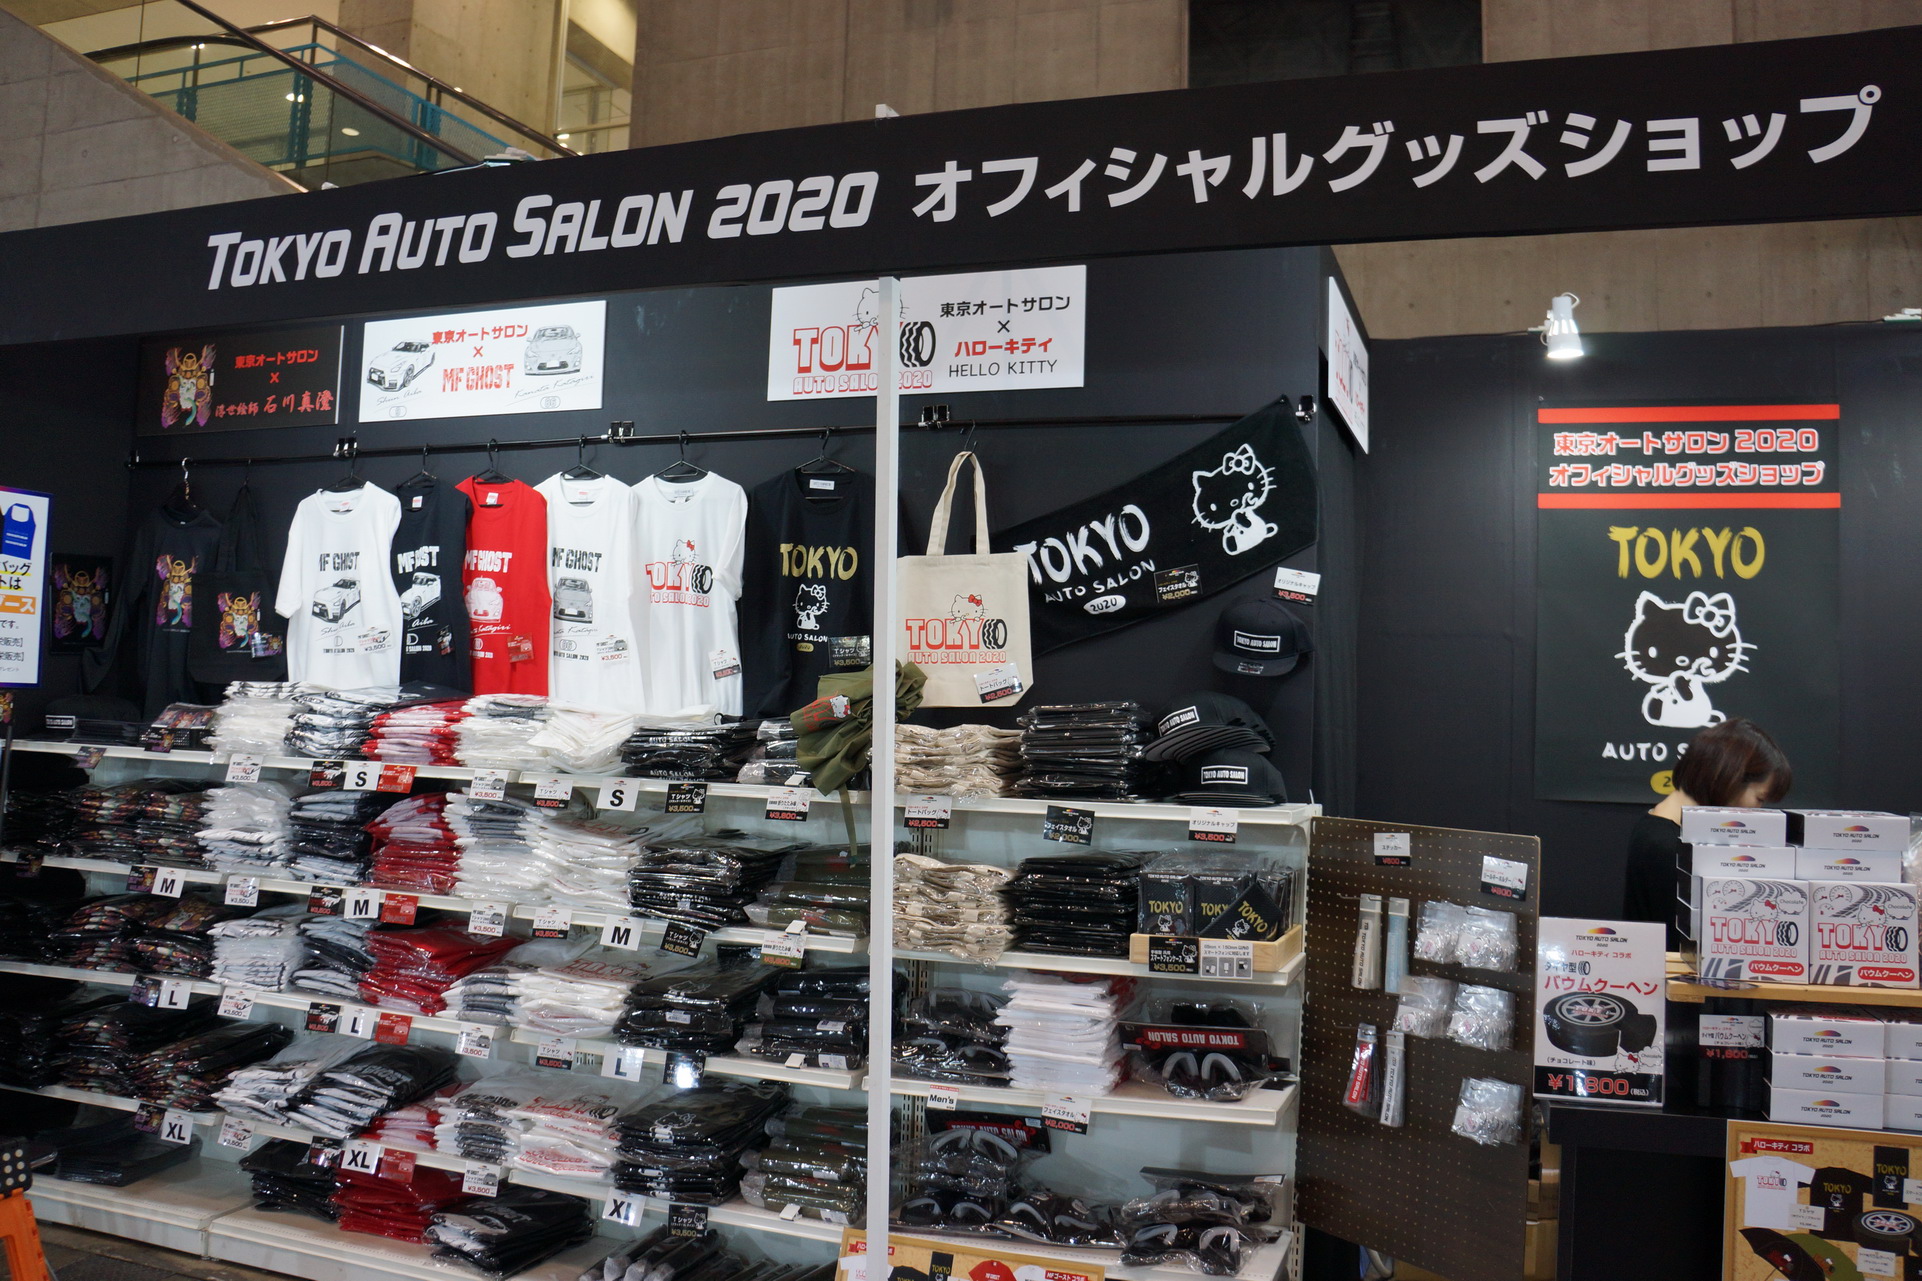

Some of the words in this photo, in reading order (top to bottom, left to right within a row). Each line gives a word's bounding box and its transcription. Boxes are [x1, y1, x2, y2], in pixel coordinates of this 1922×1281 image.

[207, 228, 352, 290] TOKYO
[358, 211, 498, 274] AUTO
[506, 189, 694, 258] SALON
[707, 171, 879, 239] 2020
[913, 84, 1882, 223] オフィシャルグッズショップ
[940, 296, 1070, 317] 東京オートサロン
[432, 325, 529, 345] 東京オートサロン
[955, 337, 1053, 357] ハローキティ
[235, 350, 318, 369] 東京オートサロン
[949, 363, 1000, 378] HELLO
[1007, 359, 1057, 375] KITTY
[442, 368, 465, 393] MF
[466, 364, 514, 391] GHOST
[793, 375, 835, 395] AUTO
[215, 402, 259, 418] 浮世絵師
[264, 389, 334, 413] 石川真澄
[1554, 431, 1729, 455] 東京オートサロン
[1734, 428, 1819, 453] 2020
[1549, 460, 1826, 487] オフィシャルグッズショップ
[1013, 504, 1150, 585] TOKYO
[1607, 525, 1765, 580] TOKYO
[397, 551, 414, 574] MF
[478, 550, 513, 573] GHOST
[566, 549, 602, 573] GHOST
[779, 543, 858, 581] TOKYO
[1045, 586, 1086, 603] AUTO
[1093, 558, 1156, 593] SALON
[1158, 583, 1187, 593] フェイスタオル
[1278, 579, 1316, 590] オリジナルキャップ
[1162, 589, 1191, 600] ¥2,000
[1278, 589, 1305, 601] ¥3,500
[1089, 597, 1118, 612] 2020
[804, 633, 828, 642] SALON
[906, 618, 1008, 650] TOKYO
[1237, 635, 1250, 645] TOKYO
[1250, 638, 1262, 647] AUTO
[1262, 640, 1277, 648] SALON
[907, 652, 938, 664] AUTO
[940, 651, 977, 664] SALON
[978, 651, 1006, 663] 2020
[980, 679, 1007, 692] トートバッグ
[985, 688, 1012, 700] ¥2,500
[1160, 721, 1169, 732] TOKYO
[1170, 716, 1180, 728] AUTO
[1180, 711, 1195, 723] SALON
[1602, 742, 1667, 762] AUTO
[355, 771, 367, 787] S
[1203, 770, 1216, 779] TOKYO
[1217, 770, 1229, 779] AUTO
[1230, 770, 1245, 780] SALON
[610, 789, 624, 807] S
[1046, 823, 1077, 832] フェイスタオル
[1192, 820, 1235, 828] オリジナルキャップ
[1194, 833, 1224, 841] ¥3,500
[160, 878, 176, 894] M
[353, 899, 369, 916] M
[1148, 900, 1183, 914] TOKYO
[1237, 900, 1268, 932] TOKYO
[611, 926, 631, 946] M
[669, 932, 688, 941] Tシャツ
[1710, 916, 1799, 946] TOKYO
[1818, 922, 1909, 952] TOKYO
[664, 943, 688, 954] ¥3,500
[1571, 950, 1610, 958] ハローキティ
[1711, 943, 1738, 954] AUTO
[1739, 944, 1771, 957] SALON
[1773, 946, 1797, 958] 2020
[1150, 954, 1182, 962] スマートフォンケース
[1819, 949, 1847, 961] AUTO
[1848, 951, 1881, 963] SALON
[1882, 952, 1907, 964] 2020
[1154, 963, 1186, 971] ¥3,500
[1545, 961, 1577, 973] タイヤ型
[1751, 962, 1802, 973] バウムクーヘン
[1859, 968, 1913, 979] バウムクーヘン
[1544, 975, 1659, 995] バウムクーヘン
[168, 990, 178, 1006] L
[351, 1017, 360, 1034] L
[1148, 1031, 1178, 1043] SALON
[1182, 1033, 1206, 1044] AUTO
[1209, 1035, 1239, 1045] TOKYO
[1715, 1032, 1747, 1041] バウムクーヘン
[614, 1058, 627, 1077] L
[1352, 1081, 1360, 1099] SALON
[929, 1094, 954, 1105] Men's
[1044, 1107, 1075, 1118] フェイスタオル
[166, 1122, 186, 1141] XL
[1045, 1118, 1075, 1131] ¥2,000
[1753, 1140, 1789, 1150] ハローキティ
[1791, 1144, 1811, 1152] コラボ
[347, 1149, 370, 1169] XL
[1876, 1163, 1907, 1176] TOKYO
[468, 1185, 490, 1194] ¥3,500
[1823, 1183, 1852, 1194] TOKYO
[671, 1229, 696, 1237] ¥3,500
[932, 1264, 951, 1275] TOKYO
[1047, 1271, 1071, 1281] MFゴースト
